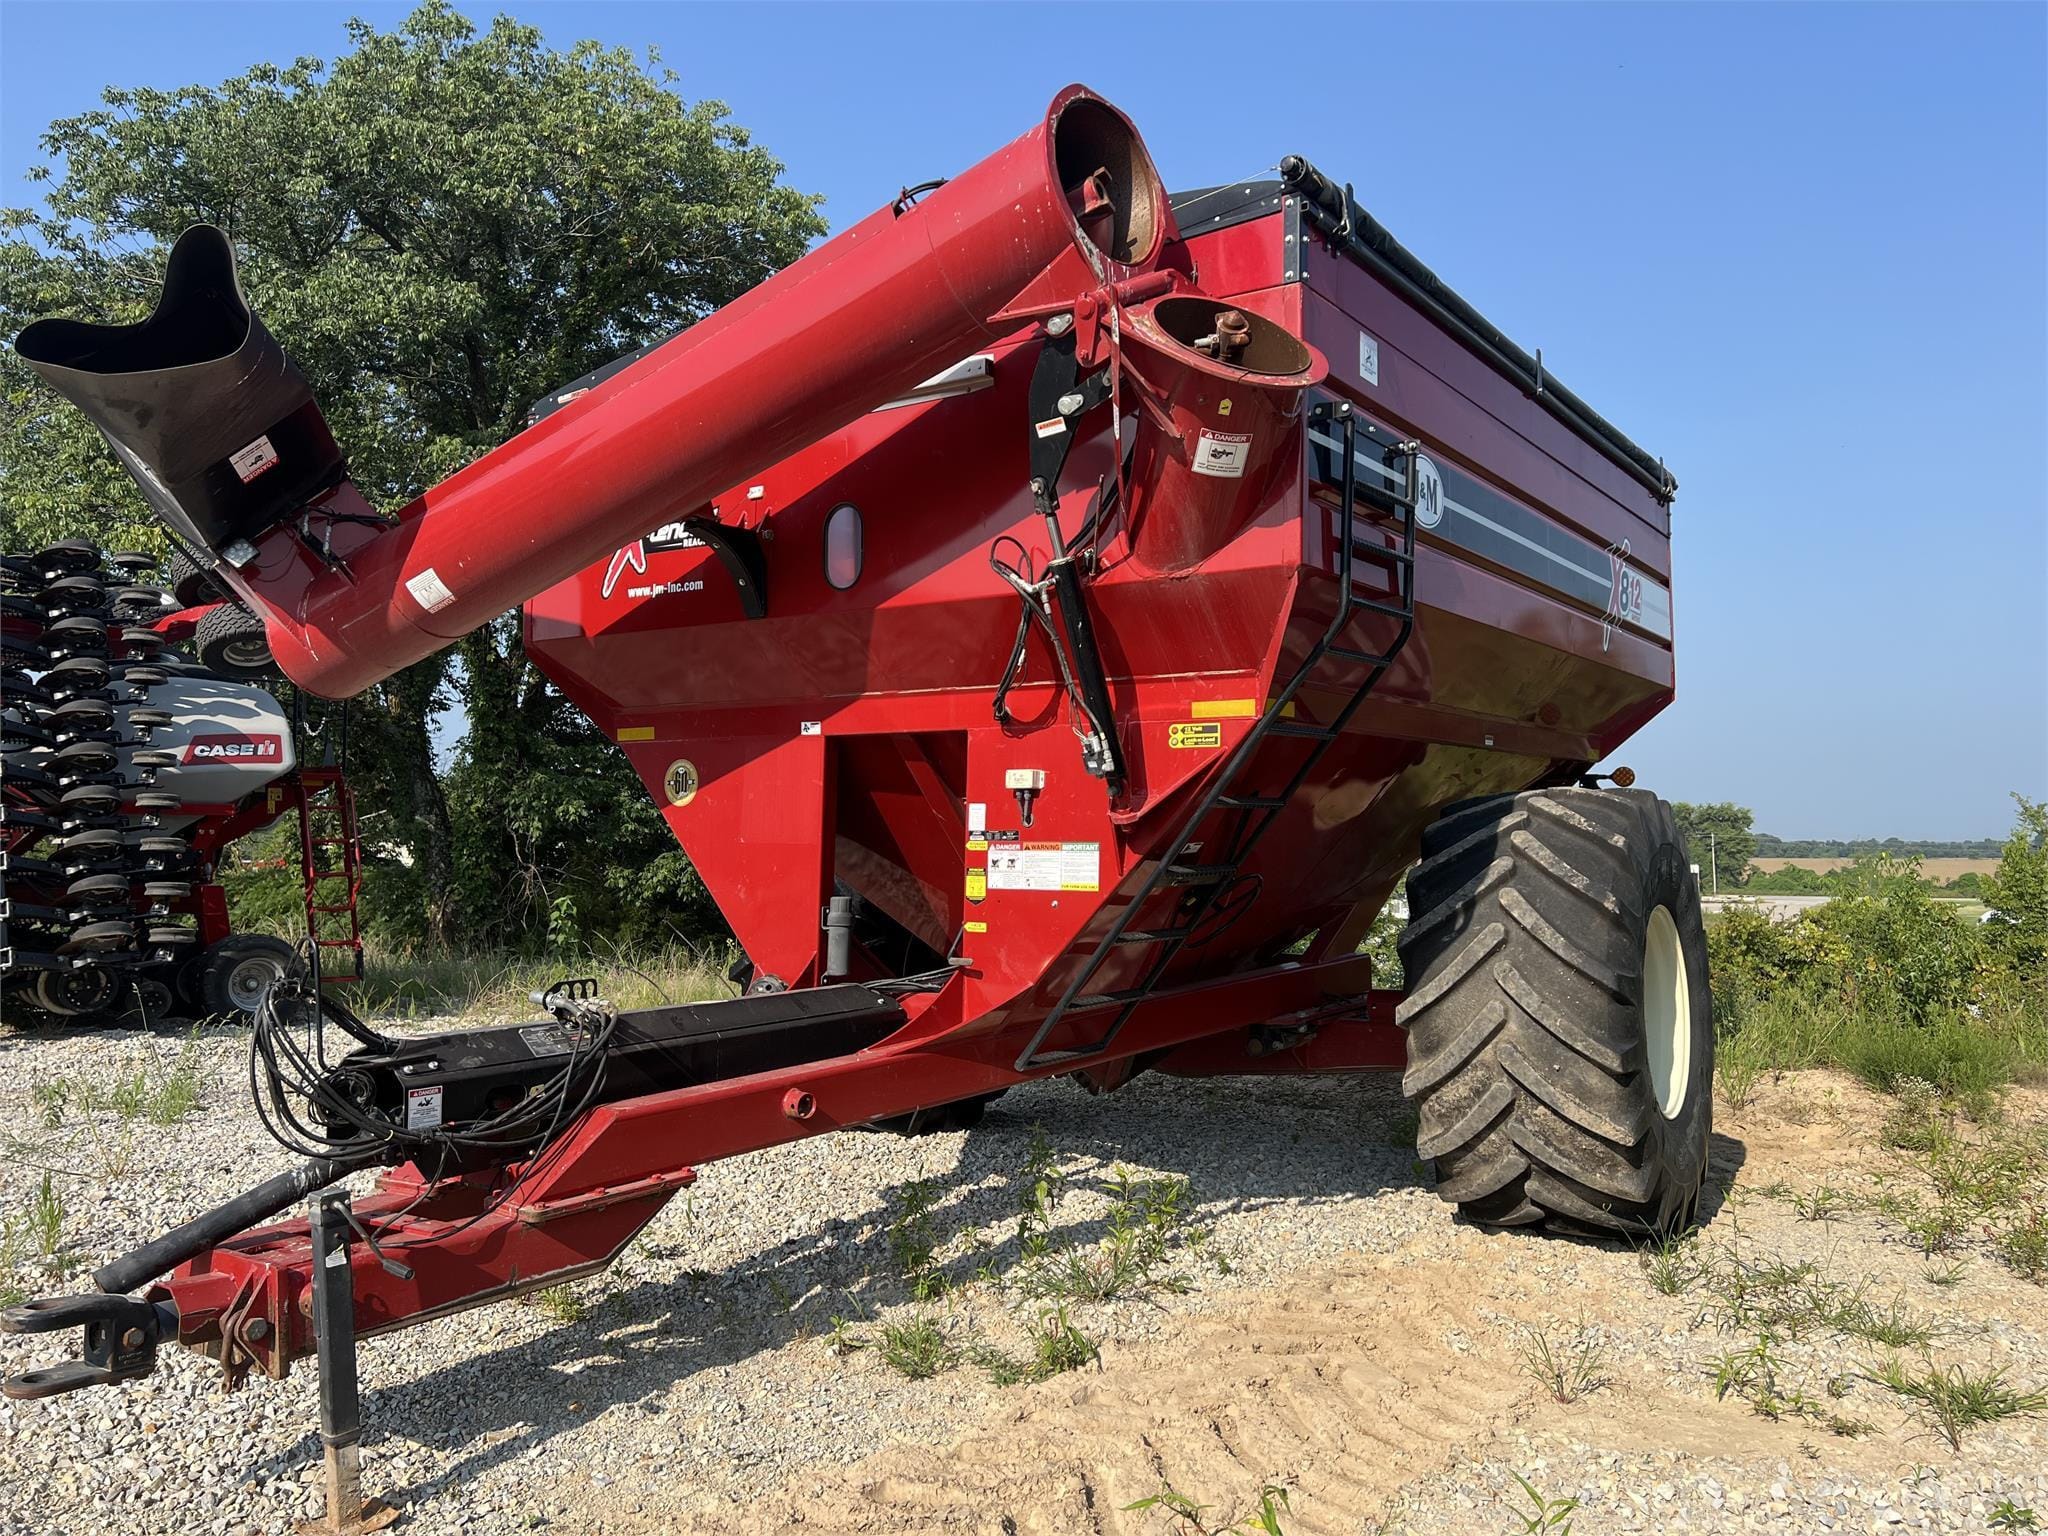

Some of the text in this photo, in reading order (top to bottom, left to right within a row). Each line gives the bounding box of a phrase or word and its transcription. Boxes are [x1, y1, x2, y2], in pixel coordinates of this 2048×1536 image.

[1214, 433, 1247, 442] DANGER
[194, 739, 276, 757] CASE IH
[1030, 843, 1060, 851] WARNING
[1061, 843, 1099, 851] IMPORTANT
[418, 1088, 440, 1096] DANGER
